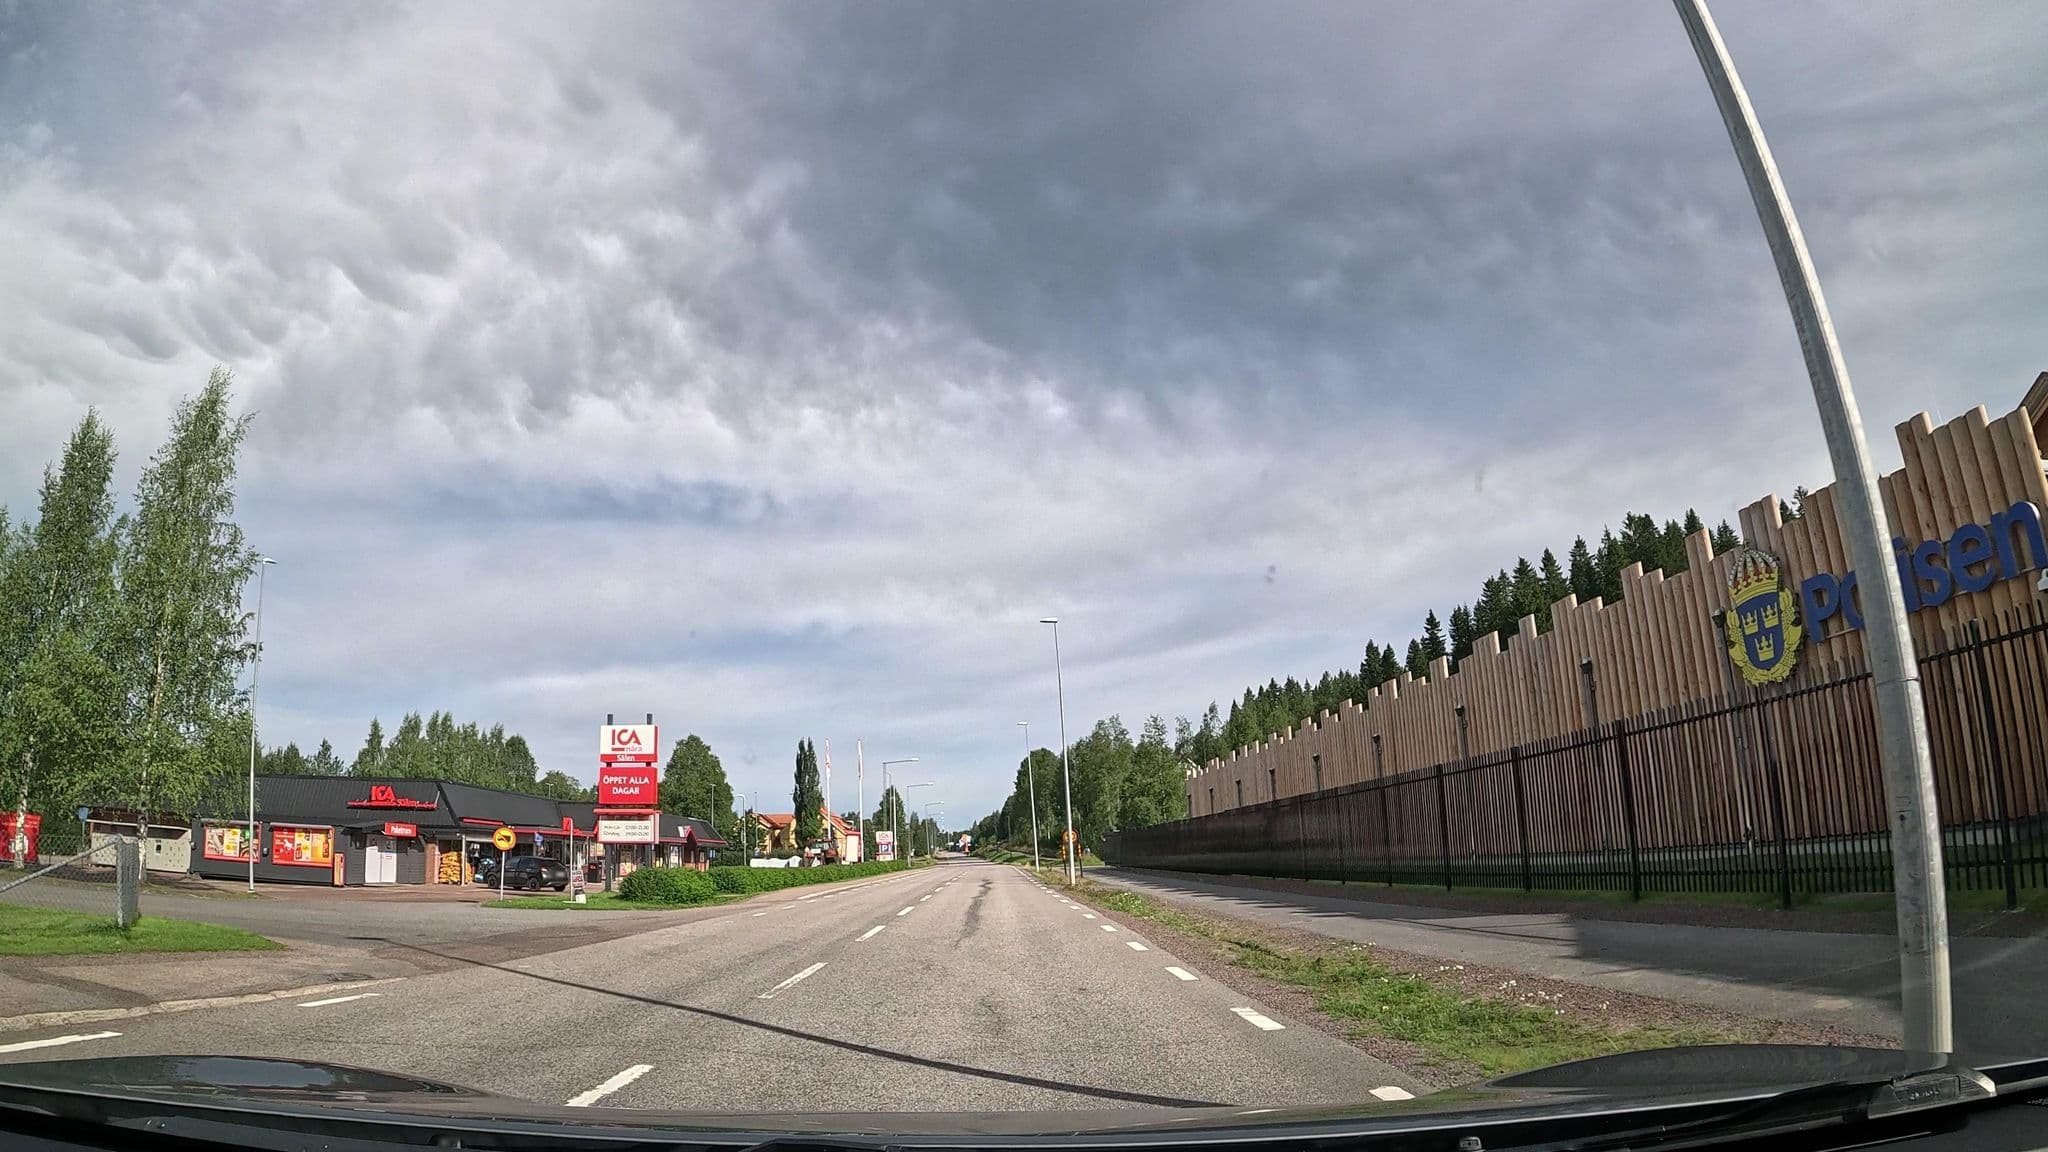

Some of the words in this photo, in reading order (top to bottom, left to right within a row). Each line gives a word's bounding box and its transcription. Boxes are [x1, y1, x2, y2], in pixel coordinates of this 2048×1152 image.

[1802, 501, 2047, 642] Poisen
[611, 729, 641, 745] ICA
[603, 775, 627, 784] ÖPPET
[371, 785, 396, 801] ICA
[612, 786, 640, 795] DAGAR
